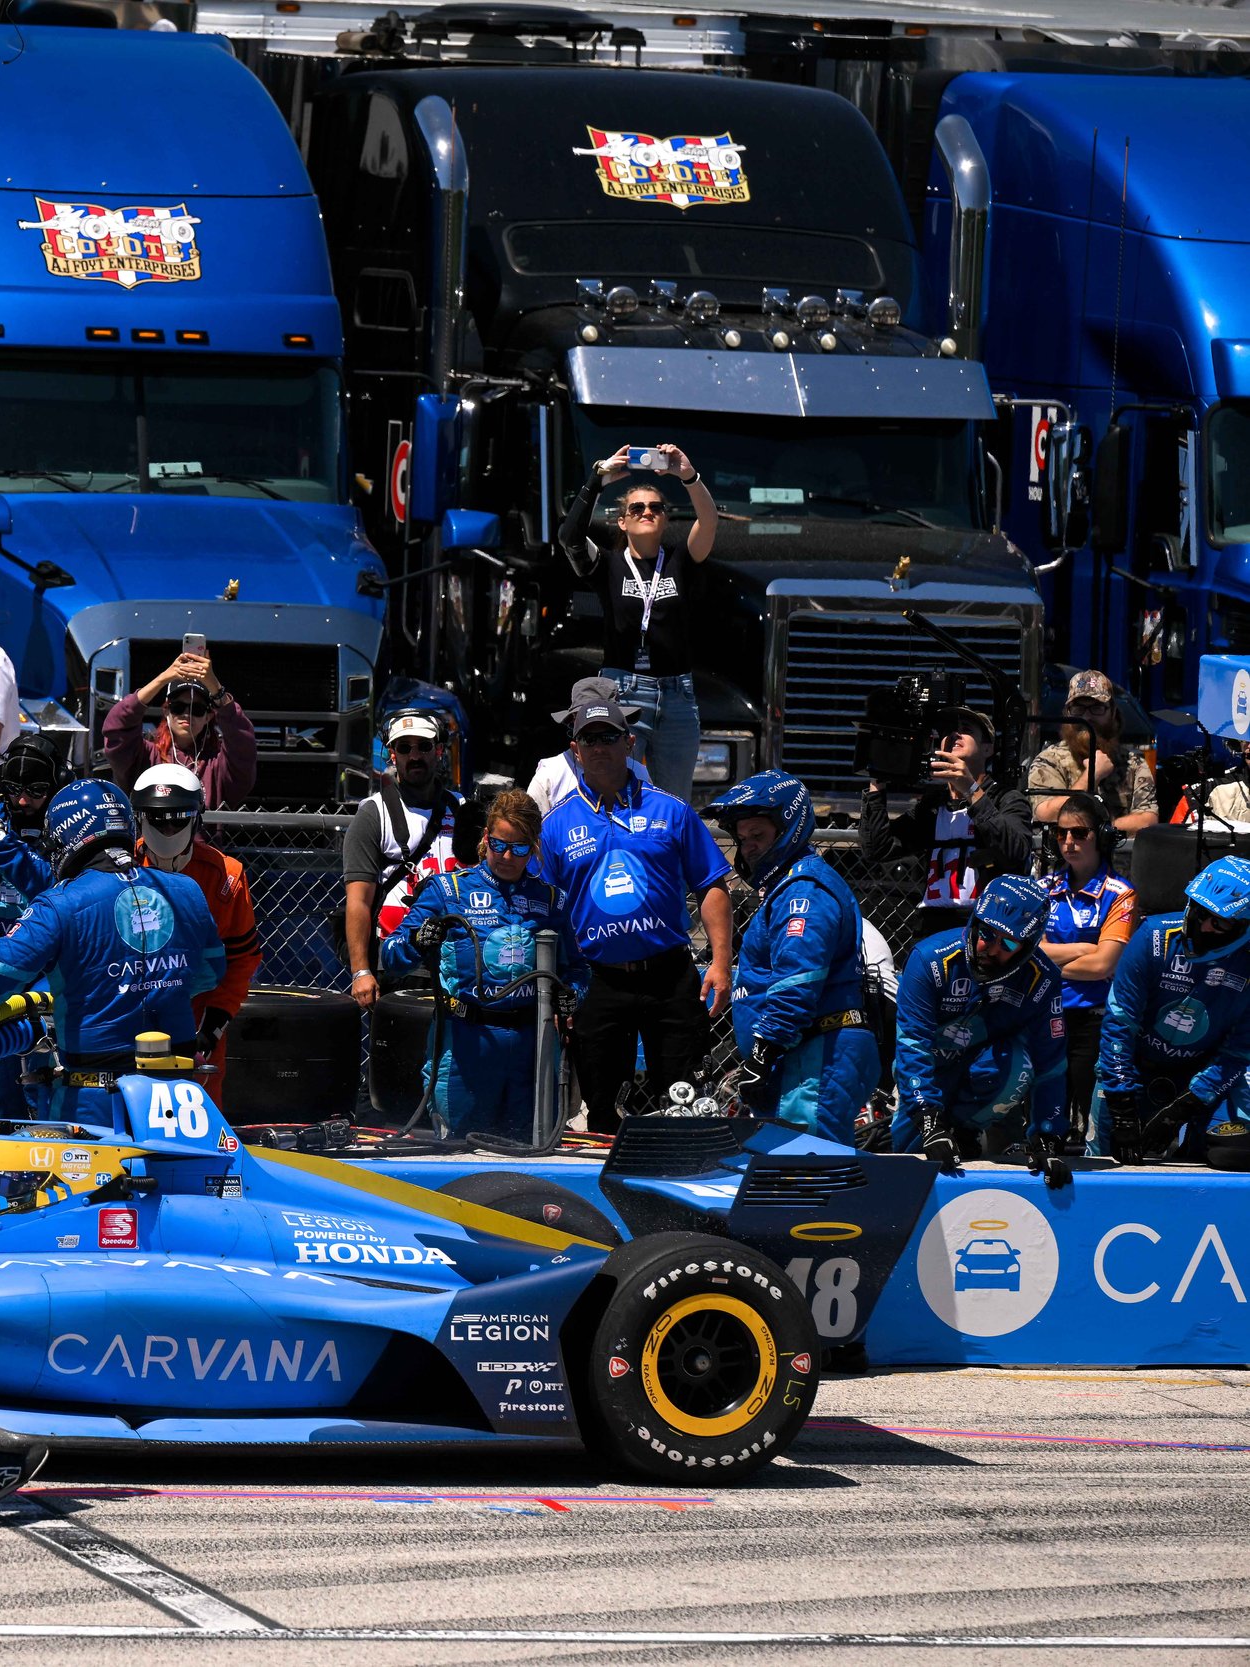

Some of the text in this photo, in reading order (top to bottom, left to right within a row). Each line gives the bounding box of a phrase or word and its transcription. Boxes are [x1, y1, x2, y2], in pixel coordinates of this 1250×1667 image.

[608, 160, 733, 183] COYOTE
[628, 182, 658, 196] FOYT
[660, 181, 747, 201] ENTERPRISES
[54, 234, 184, 258] COYOTE
[73, 258, 105, 271] FOYT
[108, 256, 197, 278] ENTERPRISES
[767, 779, 799, 794] CARVANA
[73, 815, 98, 844] CARVANA
[791, 805, 808, 844] CARVANA
[564, 837, 598, 853] HONDA
[568, 846, 598, 863] LEGION
[464, 908, 500, 916] HONDA
[585, 916, 667, 941] CARVANA
[983, 917, 1015, 936] CARVANA
[1019, 917, 1040, 939] CARVANA
[934, 940, 963, 955] Firestone
[107, 953, 189, 978] CARVANA
[929, 961, 943, 988] sparco
[1161, 972, 1195, 984] HONDA
[148, 1082, 209, 1138] 48
[226, 1142, 236, 1150] E
[74, 1153, 89, 1161] NTT
[95, 1174, 112, 1186] PPG
[282, 1215, 377, 1234] LEGION
[100, 1237, 135, 1246] Speedway
[293, 1230, 388, 1245] POWERED by
[293, 1242, 458, 1266] HONDA
[642, 1259, 784, 1301] Firestone
[480, 1314, 549, 1323] AMERICAN
[450, 1324, 550, 1342] LEGION
[759, 1325, 776, 1367] RACING
[47, 1333, 343, 1383] CARVANA
[478, 1363, 518, 1371] HPD
[543, 1382, 564, 1391] NTT
[643, 1363, 659, 1405] RACING
[498, 1401, 566, 1413] Firestone
[636, 1430, 778, 1468] Firestone
